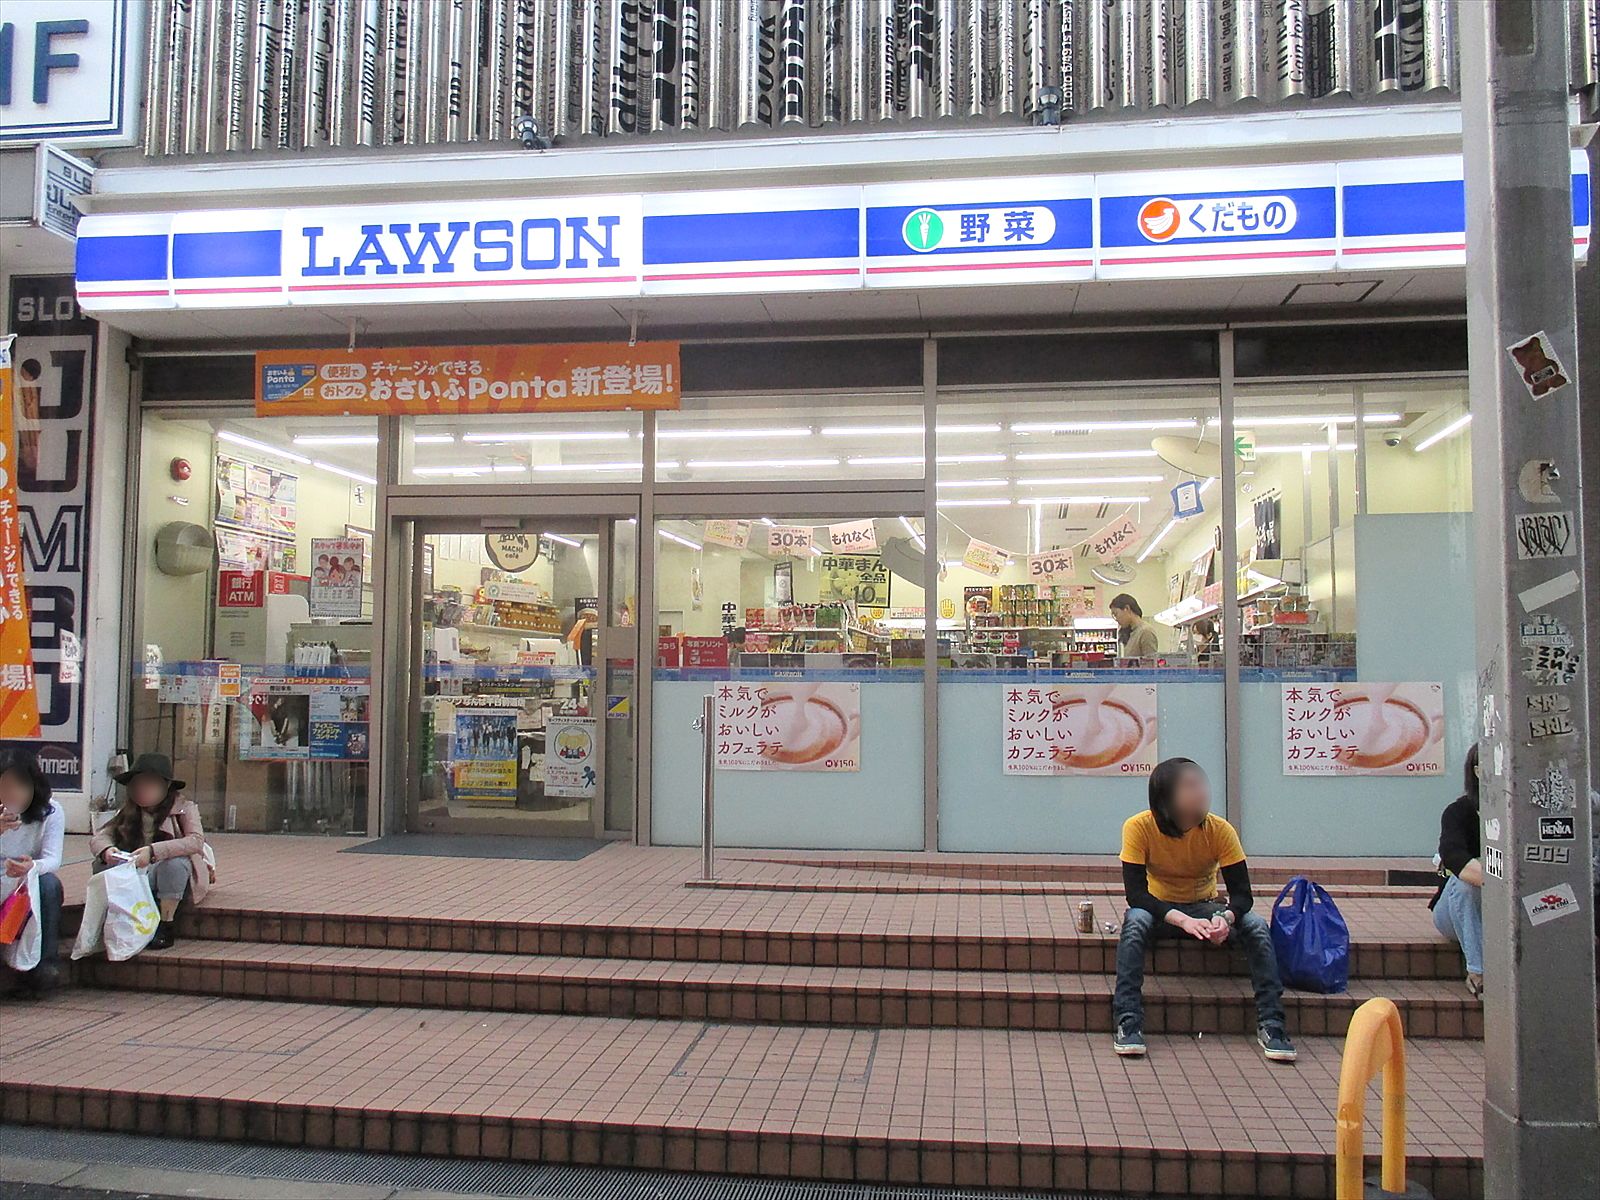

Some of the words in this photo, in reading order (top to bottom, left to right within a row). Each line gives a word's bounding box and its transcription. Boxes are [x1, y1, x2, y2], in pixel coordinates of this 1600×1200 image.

[1063, 5, 1073, 32] Easy
[1063, 48, 1072, 72] 6/49
[1188, 200, 1286, 233] くだもの
[960, 210, 1035, 243] 野菜
[301, 216, 620, 276] LAWSON
[18, 296, 87, 321] SLO
[371, 360, 482, 376] チャージができる
[323, 385, 363, 397] おトクな
[771, 532, 807, 547] 30本
[832, 528, 871, 545] もれなく
[1095, 522, 1133, 556] もれなく
[502, 545, 523, 553] MACHI
[822, 559, 887, 573] 中華まん
[1031, 558, 1069, 575] 30本
[228, 591, 254, 602] ATM
[687, 641, 724, 649] 写真プリント
[718, 685, 769, 701] 本気で
[1007, 688, 1060, 705] 本気で
[1286, 687, 1342, 704] 本気で
[560, 698, 578, 710] 24
[719, 704, 776, 719] ミルクが
[1008, 709, 1069, 723] ミルクが
[1287, 707, 1351, 722] ミルクが
[718, 723, 780, 737] おいしい
[1007, 727, 1072, 742] おいしい
[1287, 726, 1355, 741] おいしい
[718, 741, 783, 756] カフェラテ
[1007, 746, 1076, 761] カフェラテ
[1287, 745, 1359, 760] カフェラテ
[833, 760, 854, 768] ¥150
[1129, 763, 1150, 772] ¥150
[1415, 763, 1437, 771] ¥150
